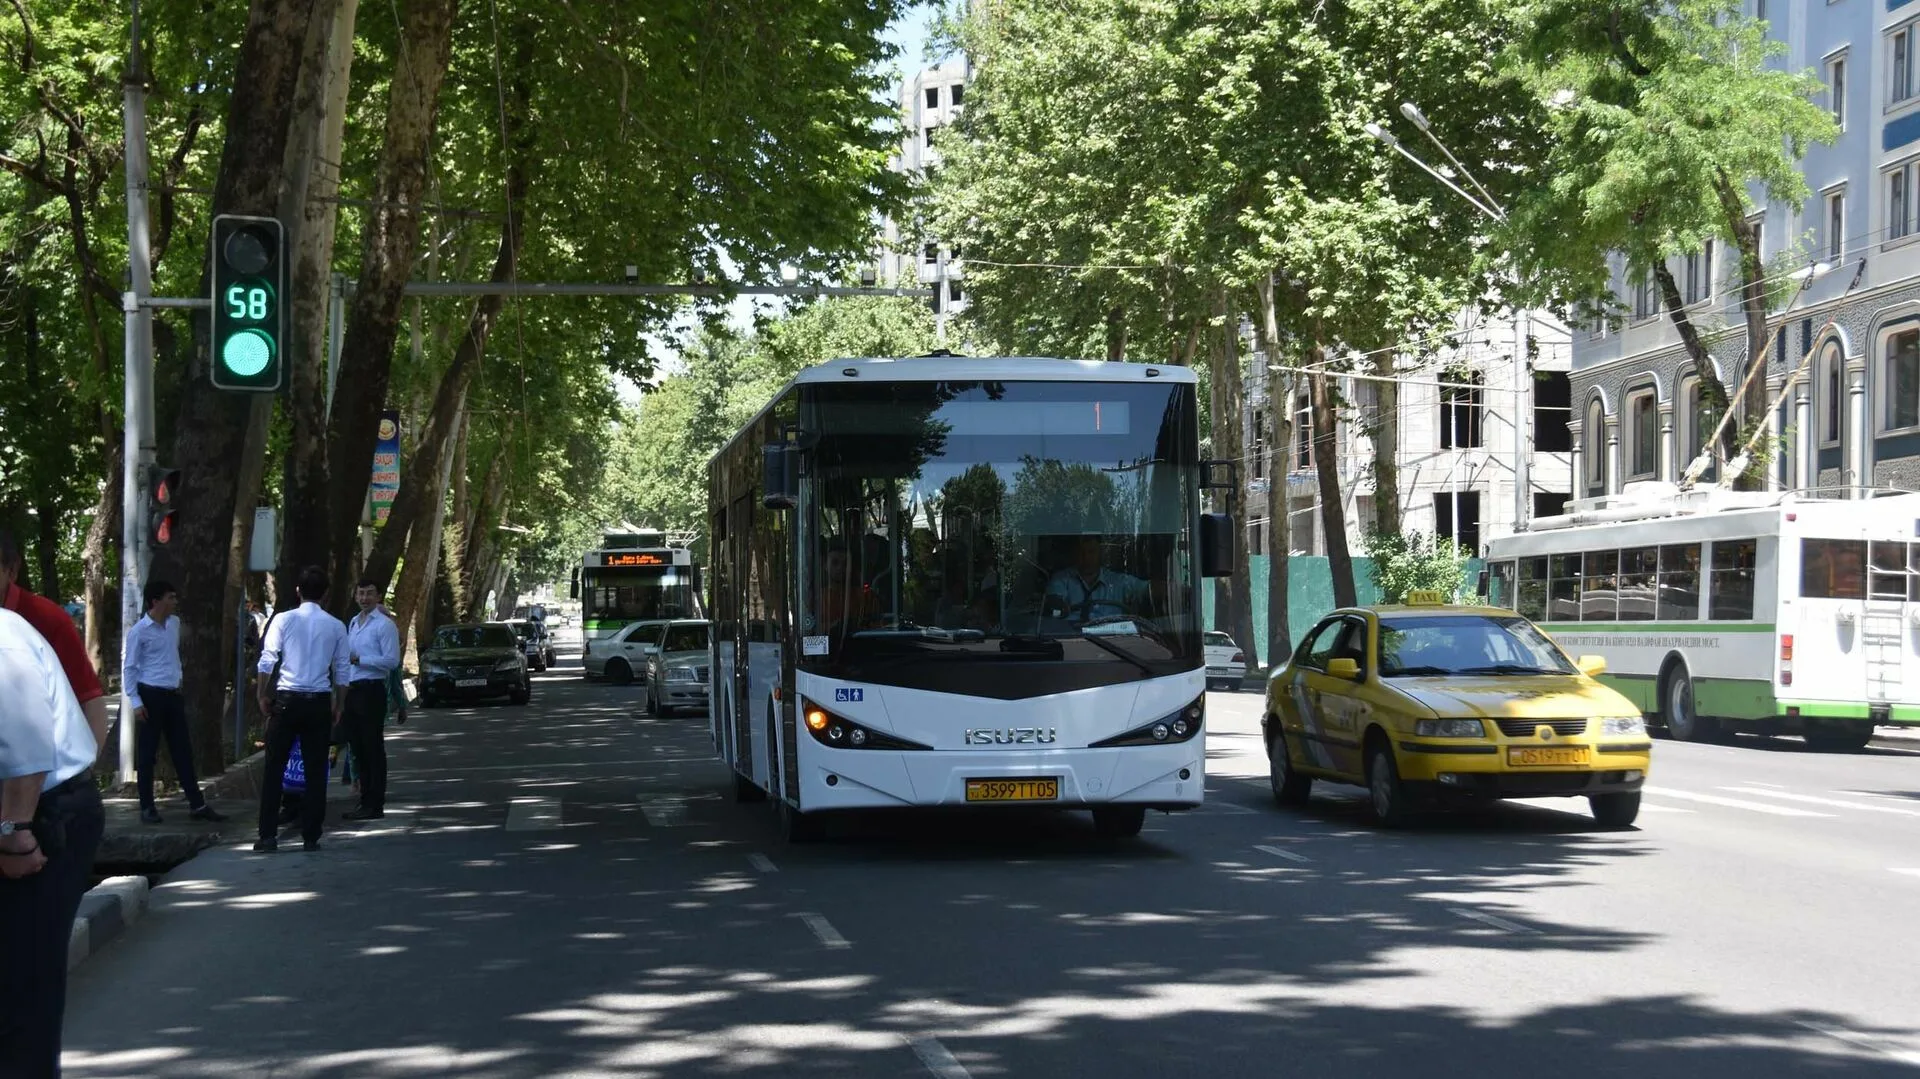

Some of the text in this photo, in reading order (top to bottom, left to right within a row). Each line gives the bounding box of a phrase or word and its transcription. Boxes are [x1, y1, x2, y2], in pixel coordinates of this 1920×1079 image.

[228, 287, 267, 320] 58
[1094, 401, 1101, 432] 1
[608, 555, 614, 565] 1
[1414, 592, 1437, 602] TAXI
[965, 727, 1056, 745] ISUZU
[982, 782, 1055, 798] 3599TT05
